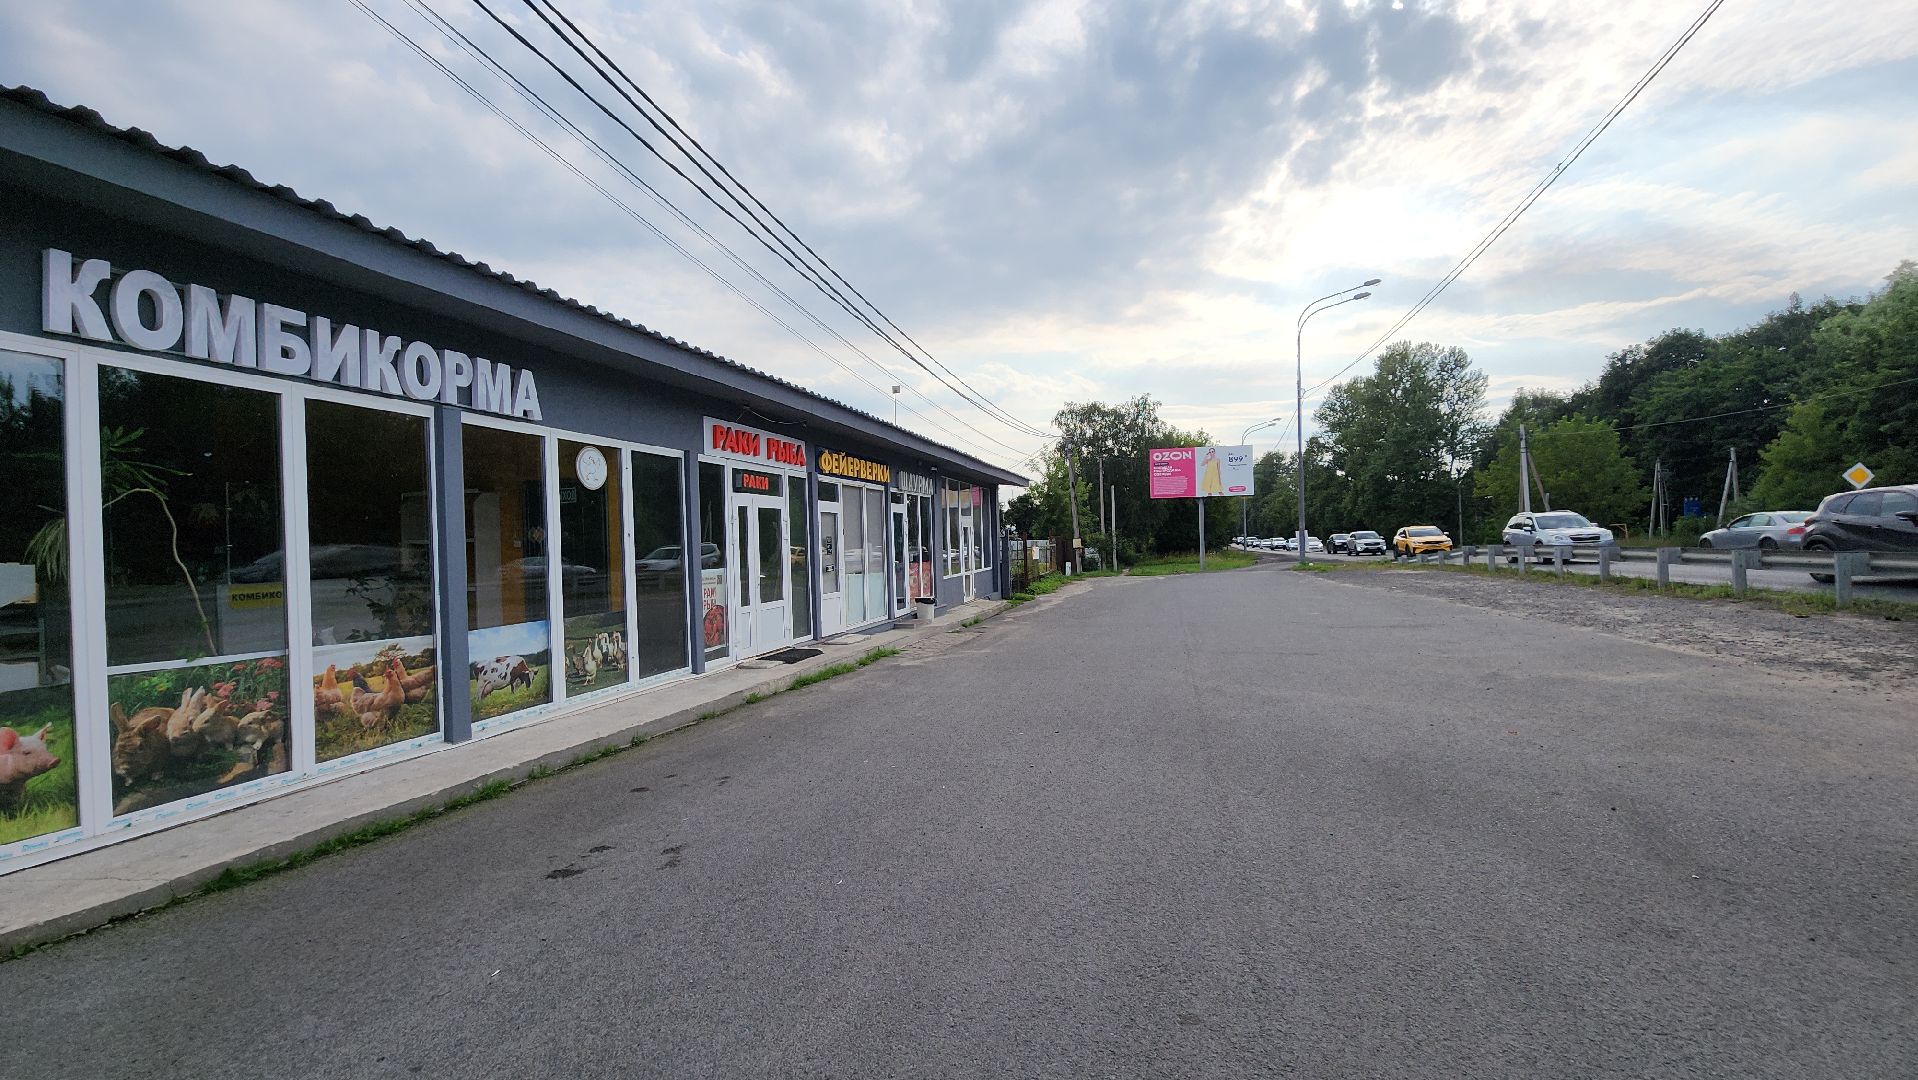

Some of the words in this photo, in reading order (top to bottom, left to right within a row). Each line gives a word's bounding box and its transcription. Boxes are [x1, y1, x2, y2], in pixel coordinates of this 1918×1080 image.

[42, 248, 543, 420] КОМБИКОРМА
[713, 425, 760, 457] РАКИ
[766, 438, 806, 467] РЫБА
[1153, 451, 1192, 461] OZON
[820, 449, 890, 483] ФЕЙЕРВЕРКИ
[743, 473, 769, 490] РАКИ
[899, 471, 934, 495] ШАУРМА
